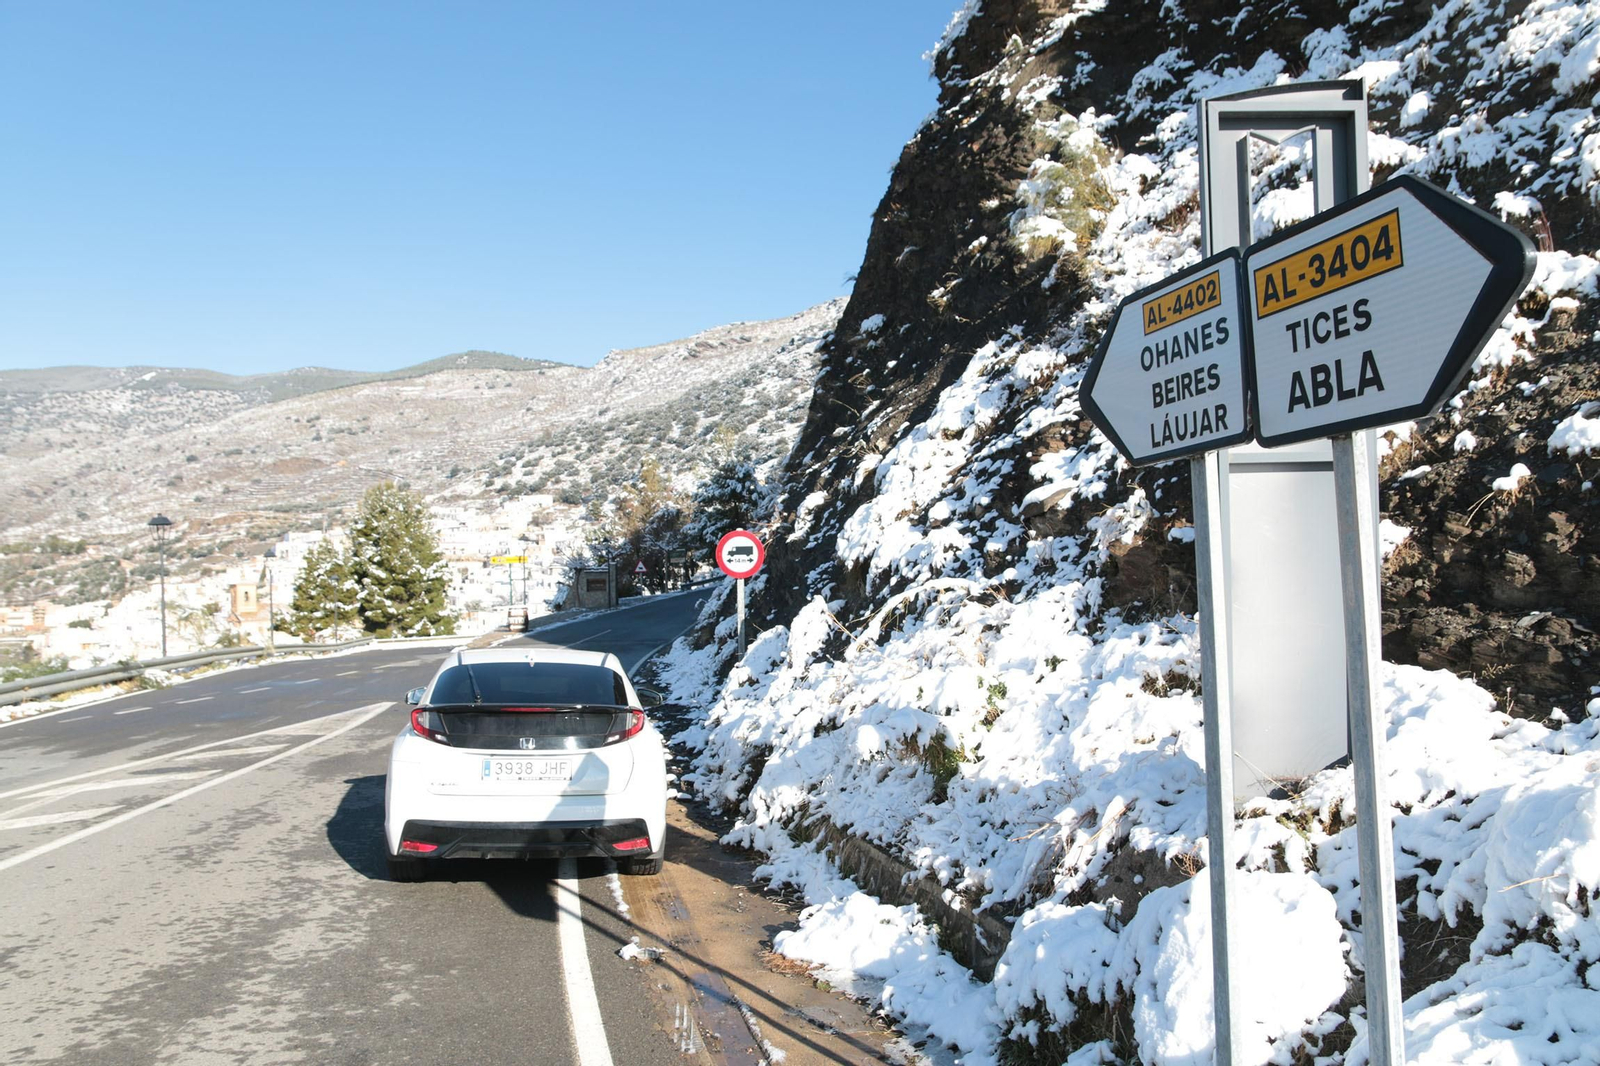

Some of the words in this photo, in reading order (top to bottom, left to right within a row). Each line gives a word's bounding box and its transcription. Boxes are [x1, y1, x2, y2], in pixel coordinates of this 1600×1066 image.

[1262, 224, 1394, 308] AL-3404
[1146, 279, 1218, 329] AL-4402
[1285, 298, 1373, 353] TICES
[1140, 317, 1230, 372] OHANES
[1152, 363, 1221, 409] BEIRES
[1287, 350, 1385, 414] ABLA
[1150, 403, 1229, 449] LÁUJAR
[495, 762, 533, 775] 3938
[539, 762, 568, 775] JHF
